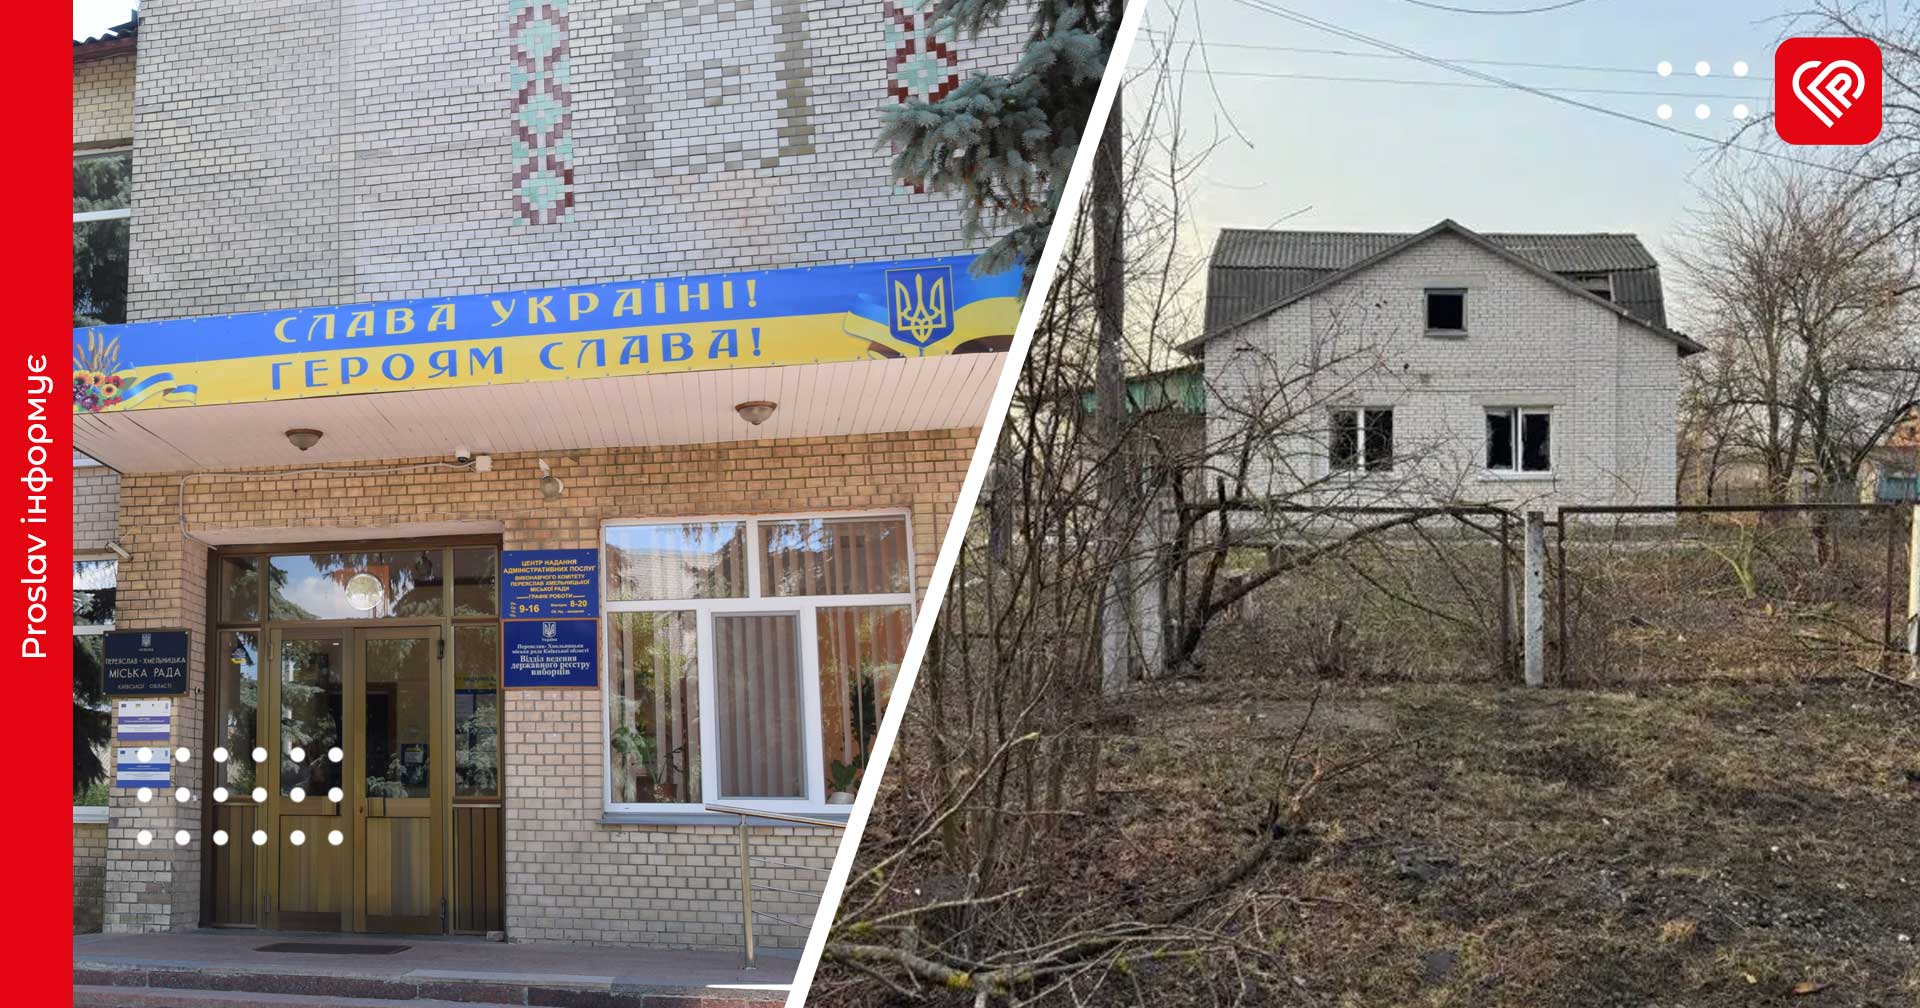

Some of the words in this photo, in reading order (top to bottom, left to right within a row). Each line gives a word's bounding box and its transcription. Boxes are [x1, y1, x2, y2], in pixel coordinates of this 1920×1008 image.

[274, 304, 456, 343] СЛАВА
[491, 279, 757, 327] УКРАЇНІ!
[271, 345, 503, 391] ГЕРОЯМ
[540, 327, 762, 370] СЛАВА!
[503, 566, 569, 574] АДМІНІСТРАТИВНИХ
[519, 604, 540, 613] 9-16
[520, 655, 544, 663] Відділ
[510, 661, 558, 671] державного
[560, 661, 590, 670] реєстру
[109, 667, 148, 679] МІСЬКА
[153, 667, 181, 678] РАДА
[530, 668, 571, 677] виборців
